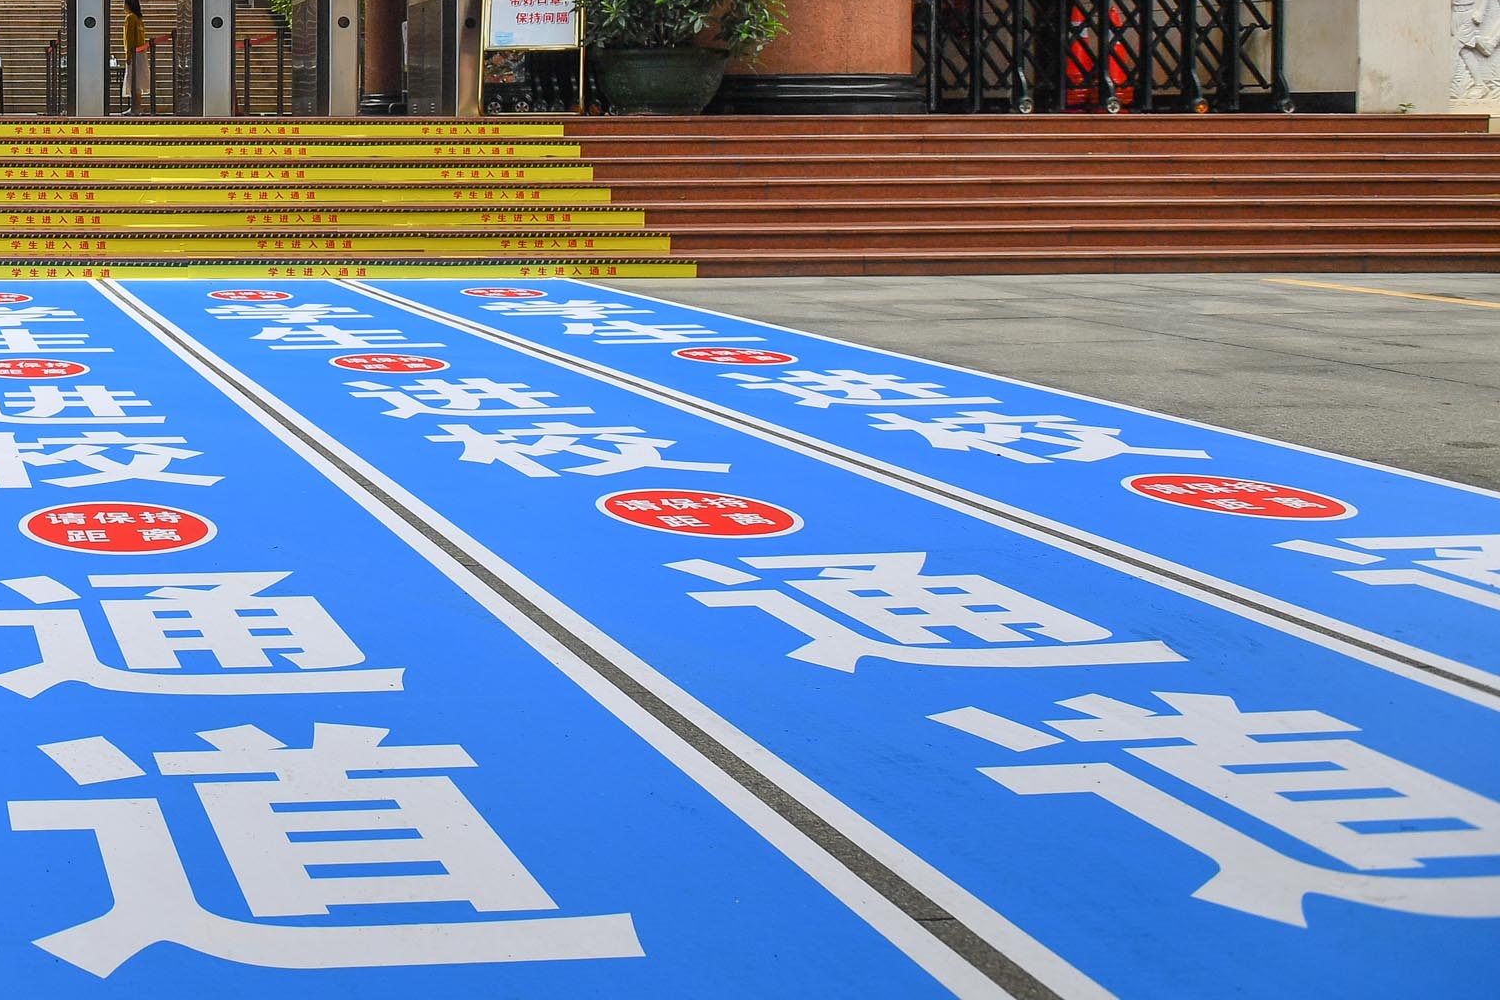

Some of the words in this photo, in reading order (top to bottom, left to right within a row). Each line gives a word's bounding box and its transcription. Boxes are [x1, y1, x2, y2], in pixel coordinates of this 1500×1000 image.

[515, 12, 571, 25] 保持间隔
[15, 126, 94, 136] 学生进入通道
[221, 126, 300, 136] 学生进入通道
[422, 127, 500, 136] 学生进入通道
[10, 146, 93, 155] 学生进入通道
[225, 147, 307, 156] 学生进入通道
[434, 147, 515, 156] 学生进入通道
[4, 169, 90, 179] 学生进入通道
[220, 170, 306, 179] 学生进入通道
[441, 170, 525, 179] 学生进入通道
[6, 191, 95, 201] 学生进入通道
[228, 191, 316, 201] 学生进入通道
[453, 190, 541, 200] 学生进入通道
[9, 215, 101, 225] 学生进入通道
[246, 214, 339, 224] 学生进入通道
[481, 213, 572, 223] 学生进入通道
[11, 240, 107, 250] 学生进入通道
[258, 239, 353, 250] 学生进入通道
[501, 238, 595, 249] 学生进入通道
[12, 268, 111, 278] 学生进入通道
[268, 267, 367, 277] 学生进入通道
[520, 266, 618, 276] 学生进入通道
[717, 369, 1213, 464] 进校
[342, 378, 732, 479] 进校
